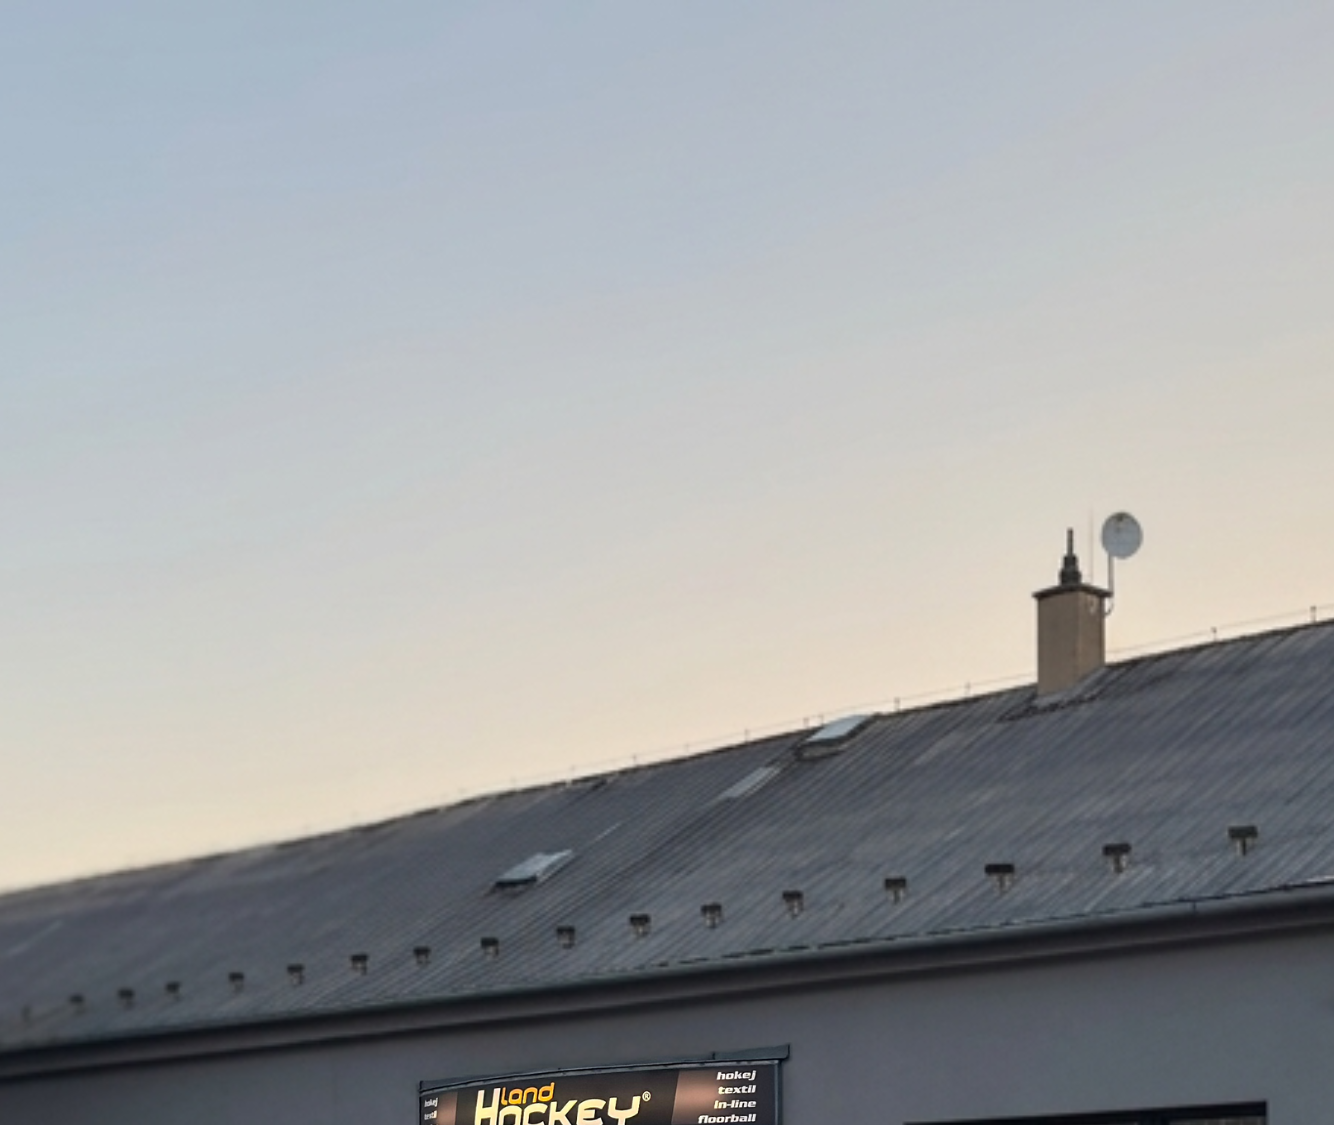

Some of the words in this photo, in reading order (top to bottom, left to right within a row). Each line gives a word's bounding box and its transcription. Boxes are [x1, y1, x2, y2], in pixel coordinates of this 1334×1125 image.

[716, 1070, 757, 1081] hokej
[500, 1082, 555, 1105] land
[717, 1084, 757, 1095] textil
[697, 1113, 757, 1124] floorball
